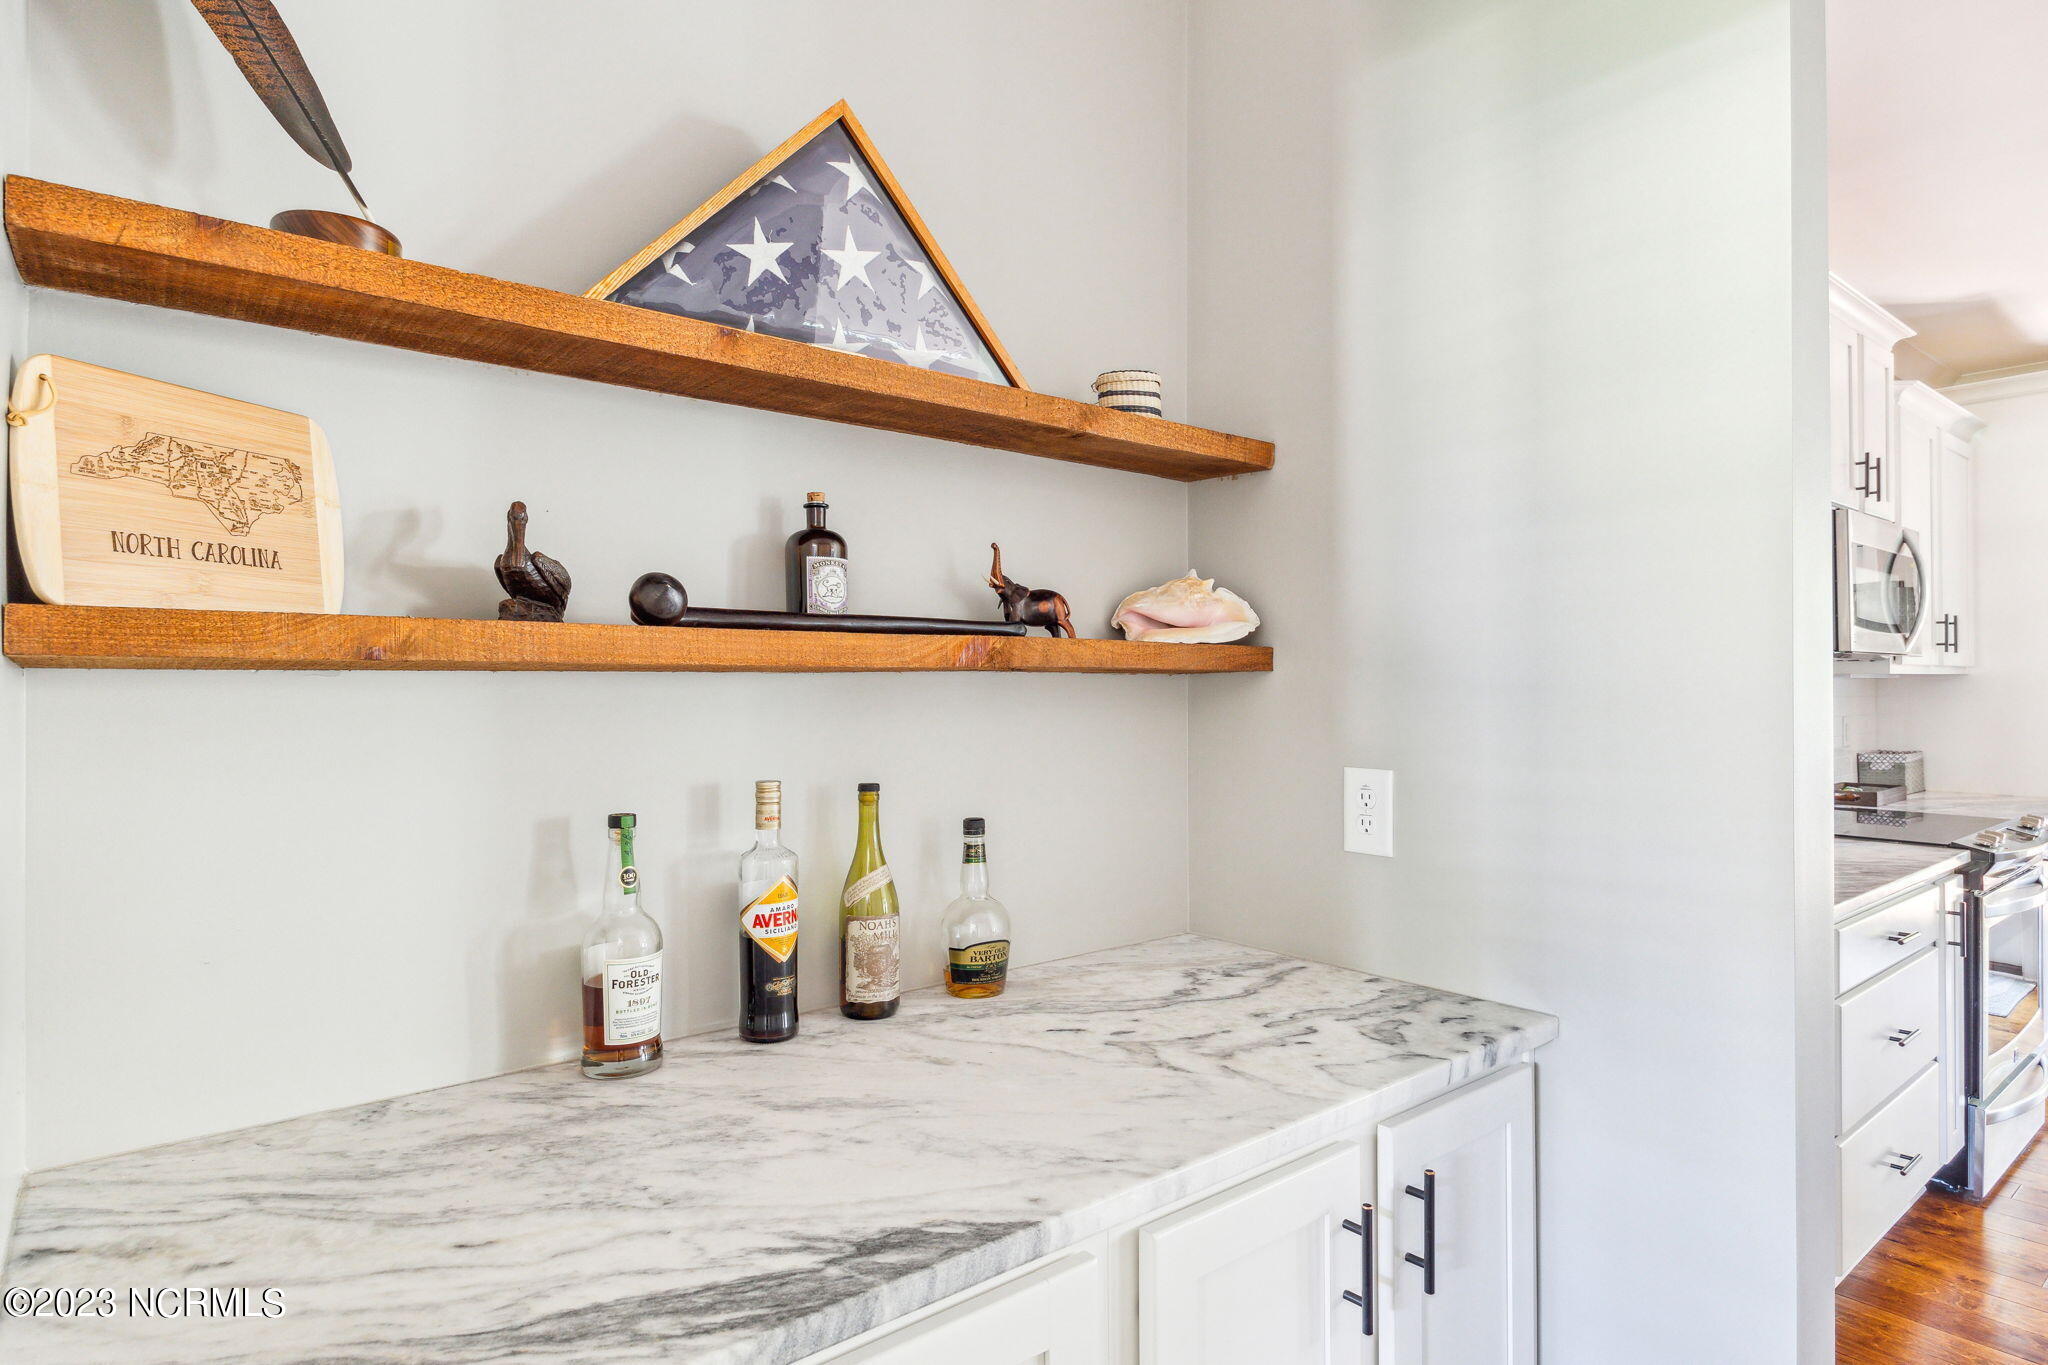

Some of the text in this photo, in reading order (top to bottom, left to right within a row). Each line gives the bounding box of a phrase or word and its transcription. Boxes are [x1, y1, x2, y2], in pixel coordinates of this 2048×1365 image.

[111, 530, 283, 570] NORTH CAROLINA
[769, 903, 795, 913] AMARO
[752, 908, 798, 929] AVERN
[859, 919, 897, 931] NOAHS
[970, 951, 1007, 963] BARTON
[630, 969, 649, 979] OLD
[611, 973, 660, 990] FORESTER
[627, 995, 651, 1008] 1897
